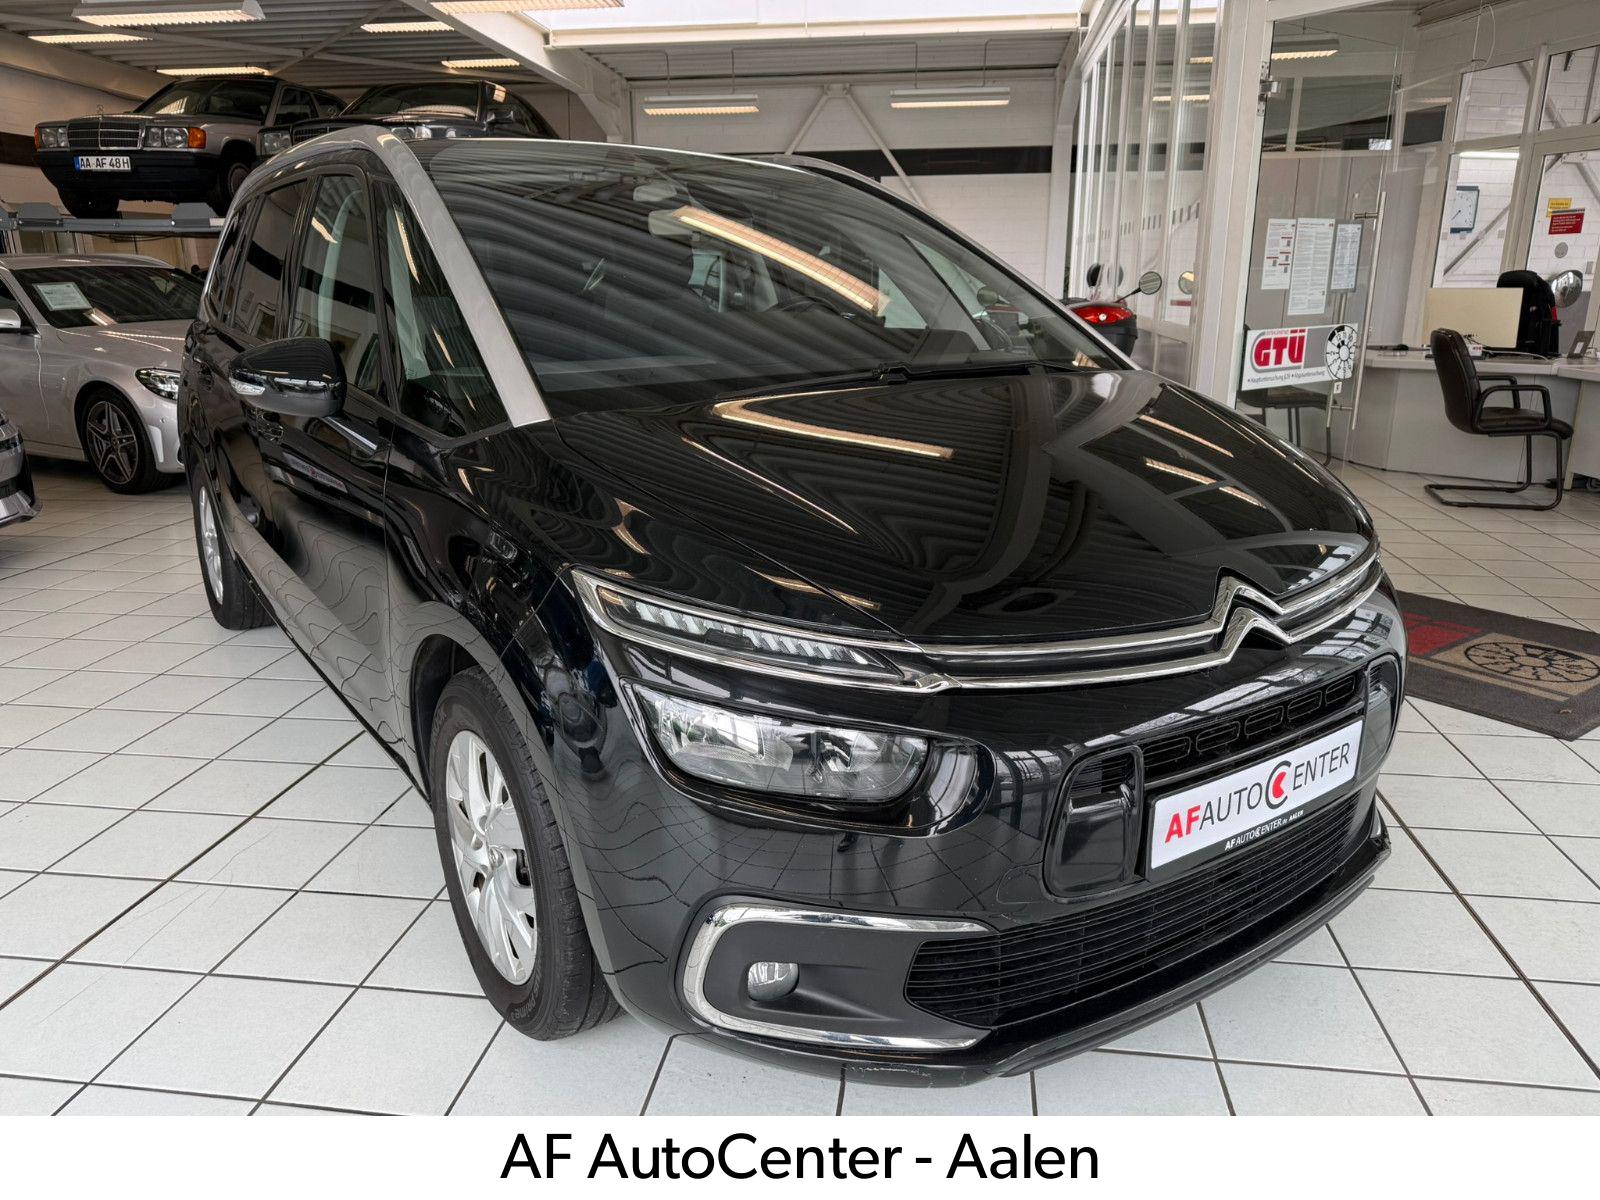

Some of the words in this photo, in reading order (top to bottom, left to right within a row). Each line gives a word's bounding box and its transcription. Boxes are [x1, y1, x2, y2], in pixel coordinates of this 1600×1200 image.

[80, 158, 91, 168] AA
[96, 157, 107, 168] AF
[1254, 329, 1306, 367] GTÜ
